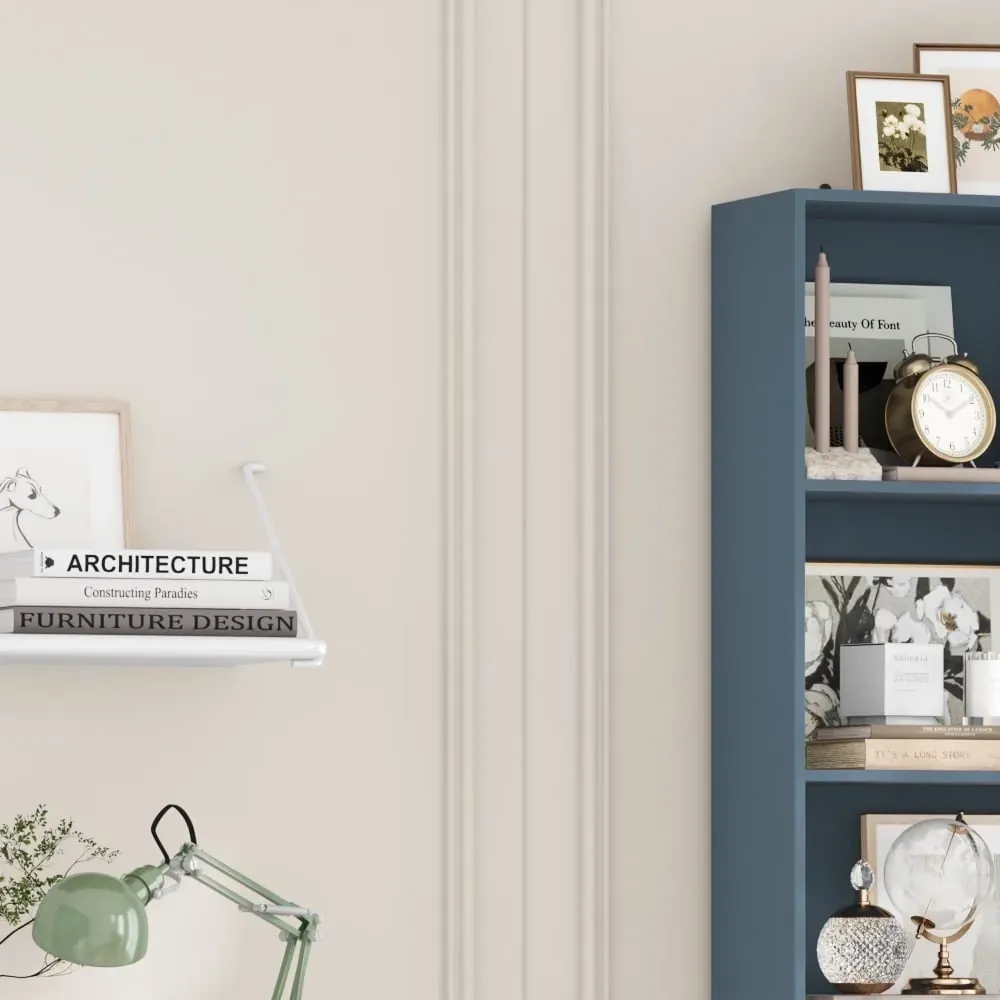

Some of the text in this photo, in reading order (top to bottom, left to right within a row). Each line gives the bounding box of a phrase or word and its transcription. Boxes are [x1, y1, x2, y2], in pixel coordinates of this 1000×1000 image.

[804, 317, 900, 331] he eauty Of Font
[67, 554, 249, 575] ARCHITECTURE
[84, 586, 198, 601] Constructing Paradies
[19, 612, 295, 632] FURNITURE DESIGN
[902, 750, 910, 760] A
[914, 750, 937, 760] LONG
[942, 750, 970, 760] STORY
